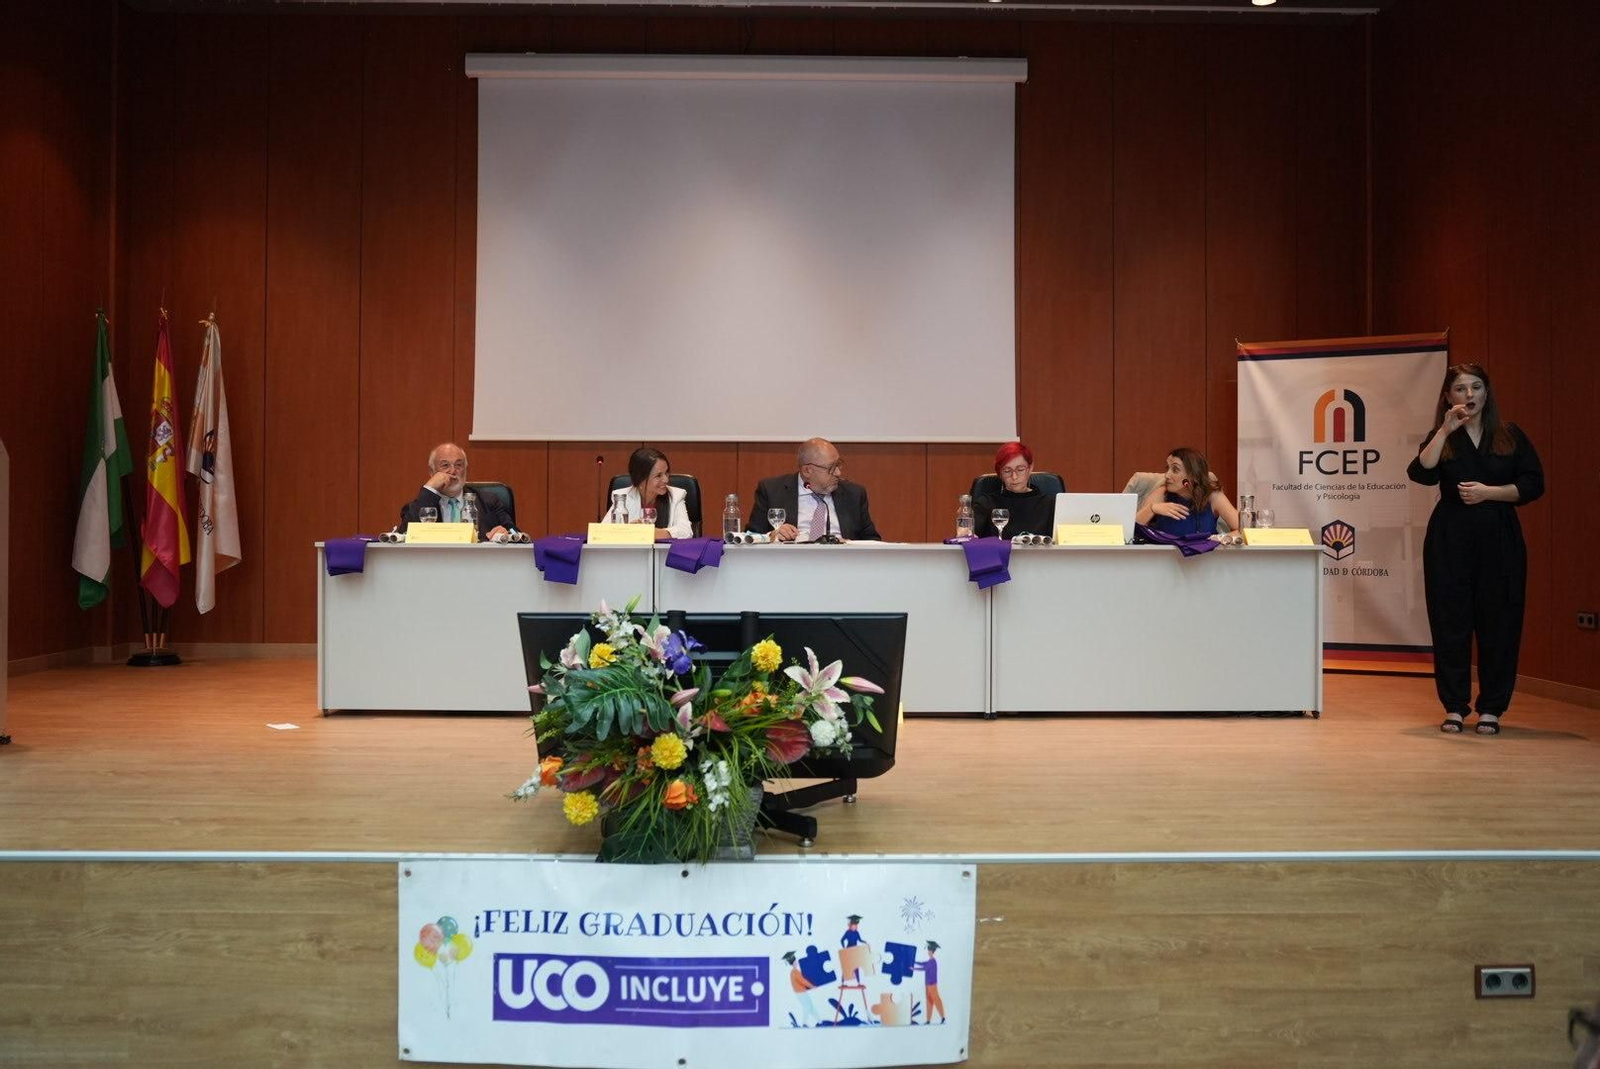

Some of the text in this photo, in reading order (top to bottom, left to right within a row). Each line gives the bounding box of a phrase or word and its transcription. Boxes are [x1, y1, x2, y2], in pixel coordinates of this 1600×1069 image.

[1298, 449, 1381, 475] FCEP
[1272, 483, 1302, 491] Facultad
[1303, 483, 1313, 491] de
[1314, 483, 1346, 491] Ciencias
[1346, 483, 1357, 491] de
[1366, 482, 1407, 490] Educación
[1323, 567, 1340, 576] DAD
[1351, 566, 1389, 577] CÓRDOBA
[474, 902, 813, 938] ¡FELIZ GRADUACIÓN!
[498, 958, 744, 1012] UCO INCLUYE
